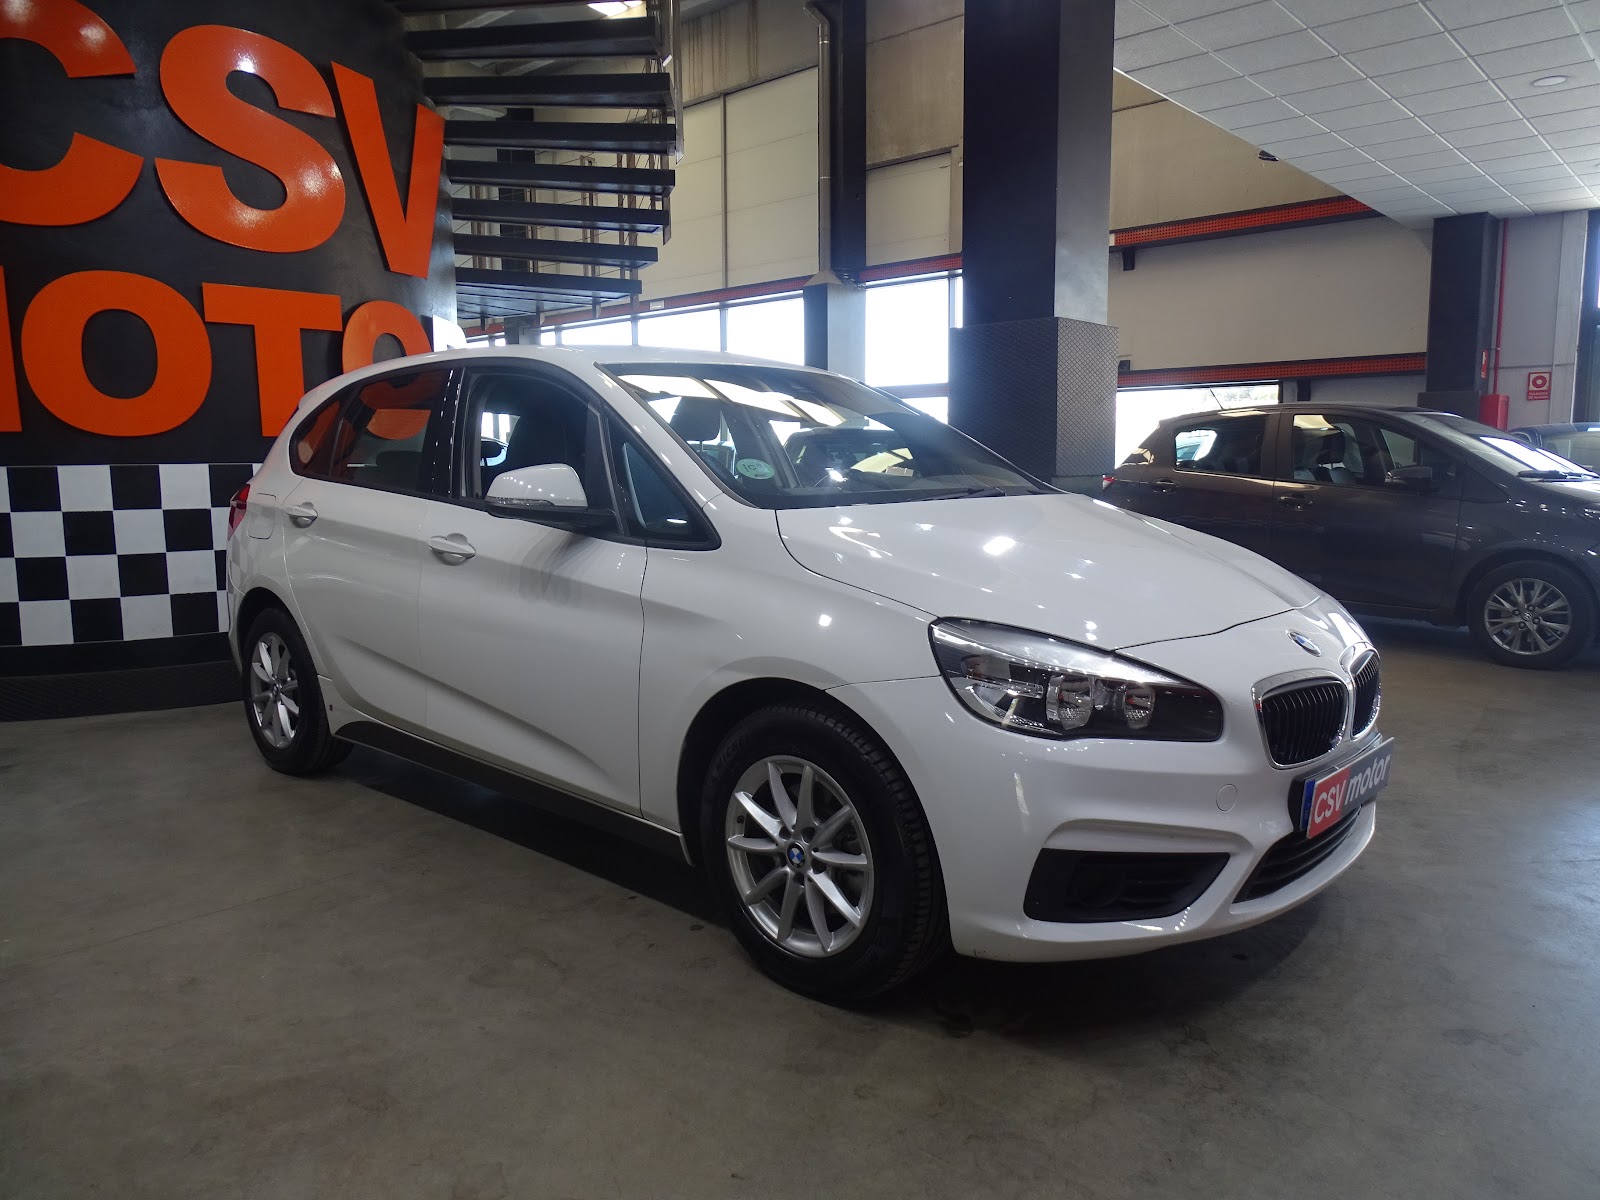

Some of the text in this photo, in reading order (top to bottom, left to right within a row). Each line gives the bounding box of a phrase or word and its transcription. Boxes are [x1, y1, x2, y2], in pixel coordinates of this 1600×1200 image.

[0, 0, 445, 279] CSV
[0, 265, 467, 438] OTO
[1314, 753, 1392, 824] CSV motor
